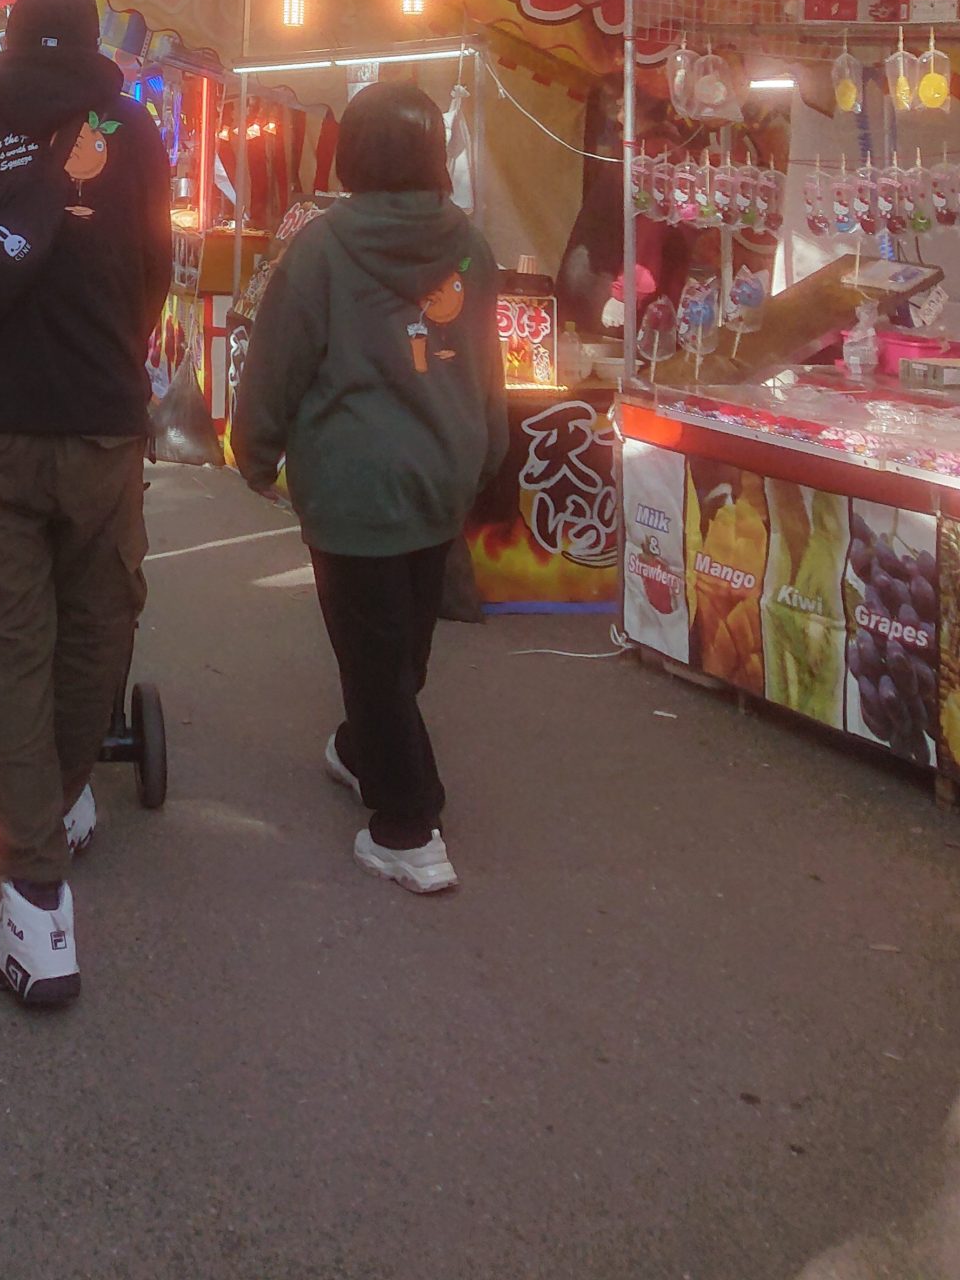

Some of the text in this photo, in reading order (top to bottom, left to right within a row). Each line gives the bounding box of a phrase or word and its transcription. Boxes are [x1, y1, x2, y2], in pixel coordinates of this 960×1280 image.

[4, 133, 20, 146] the
[5, 145, 27, 157] worth
[27, 143, 39, 152] the
[14, 243, 32, 261] CUNE
[635, 504, 671, 533] Milk
[648, 536, 661, 556] &
[628, 554, 683, 595] Strawberry
[695, 552, 756, 590] Mango
[777, 584, 823, 615] Kiwi
[855, 604, 929, 647] Grapes
[7, 918, 24, 941] FILA
